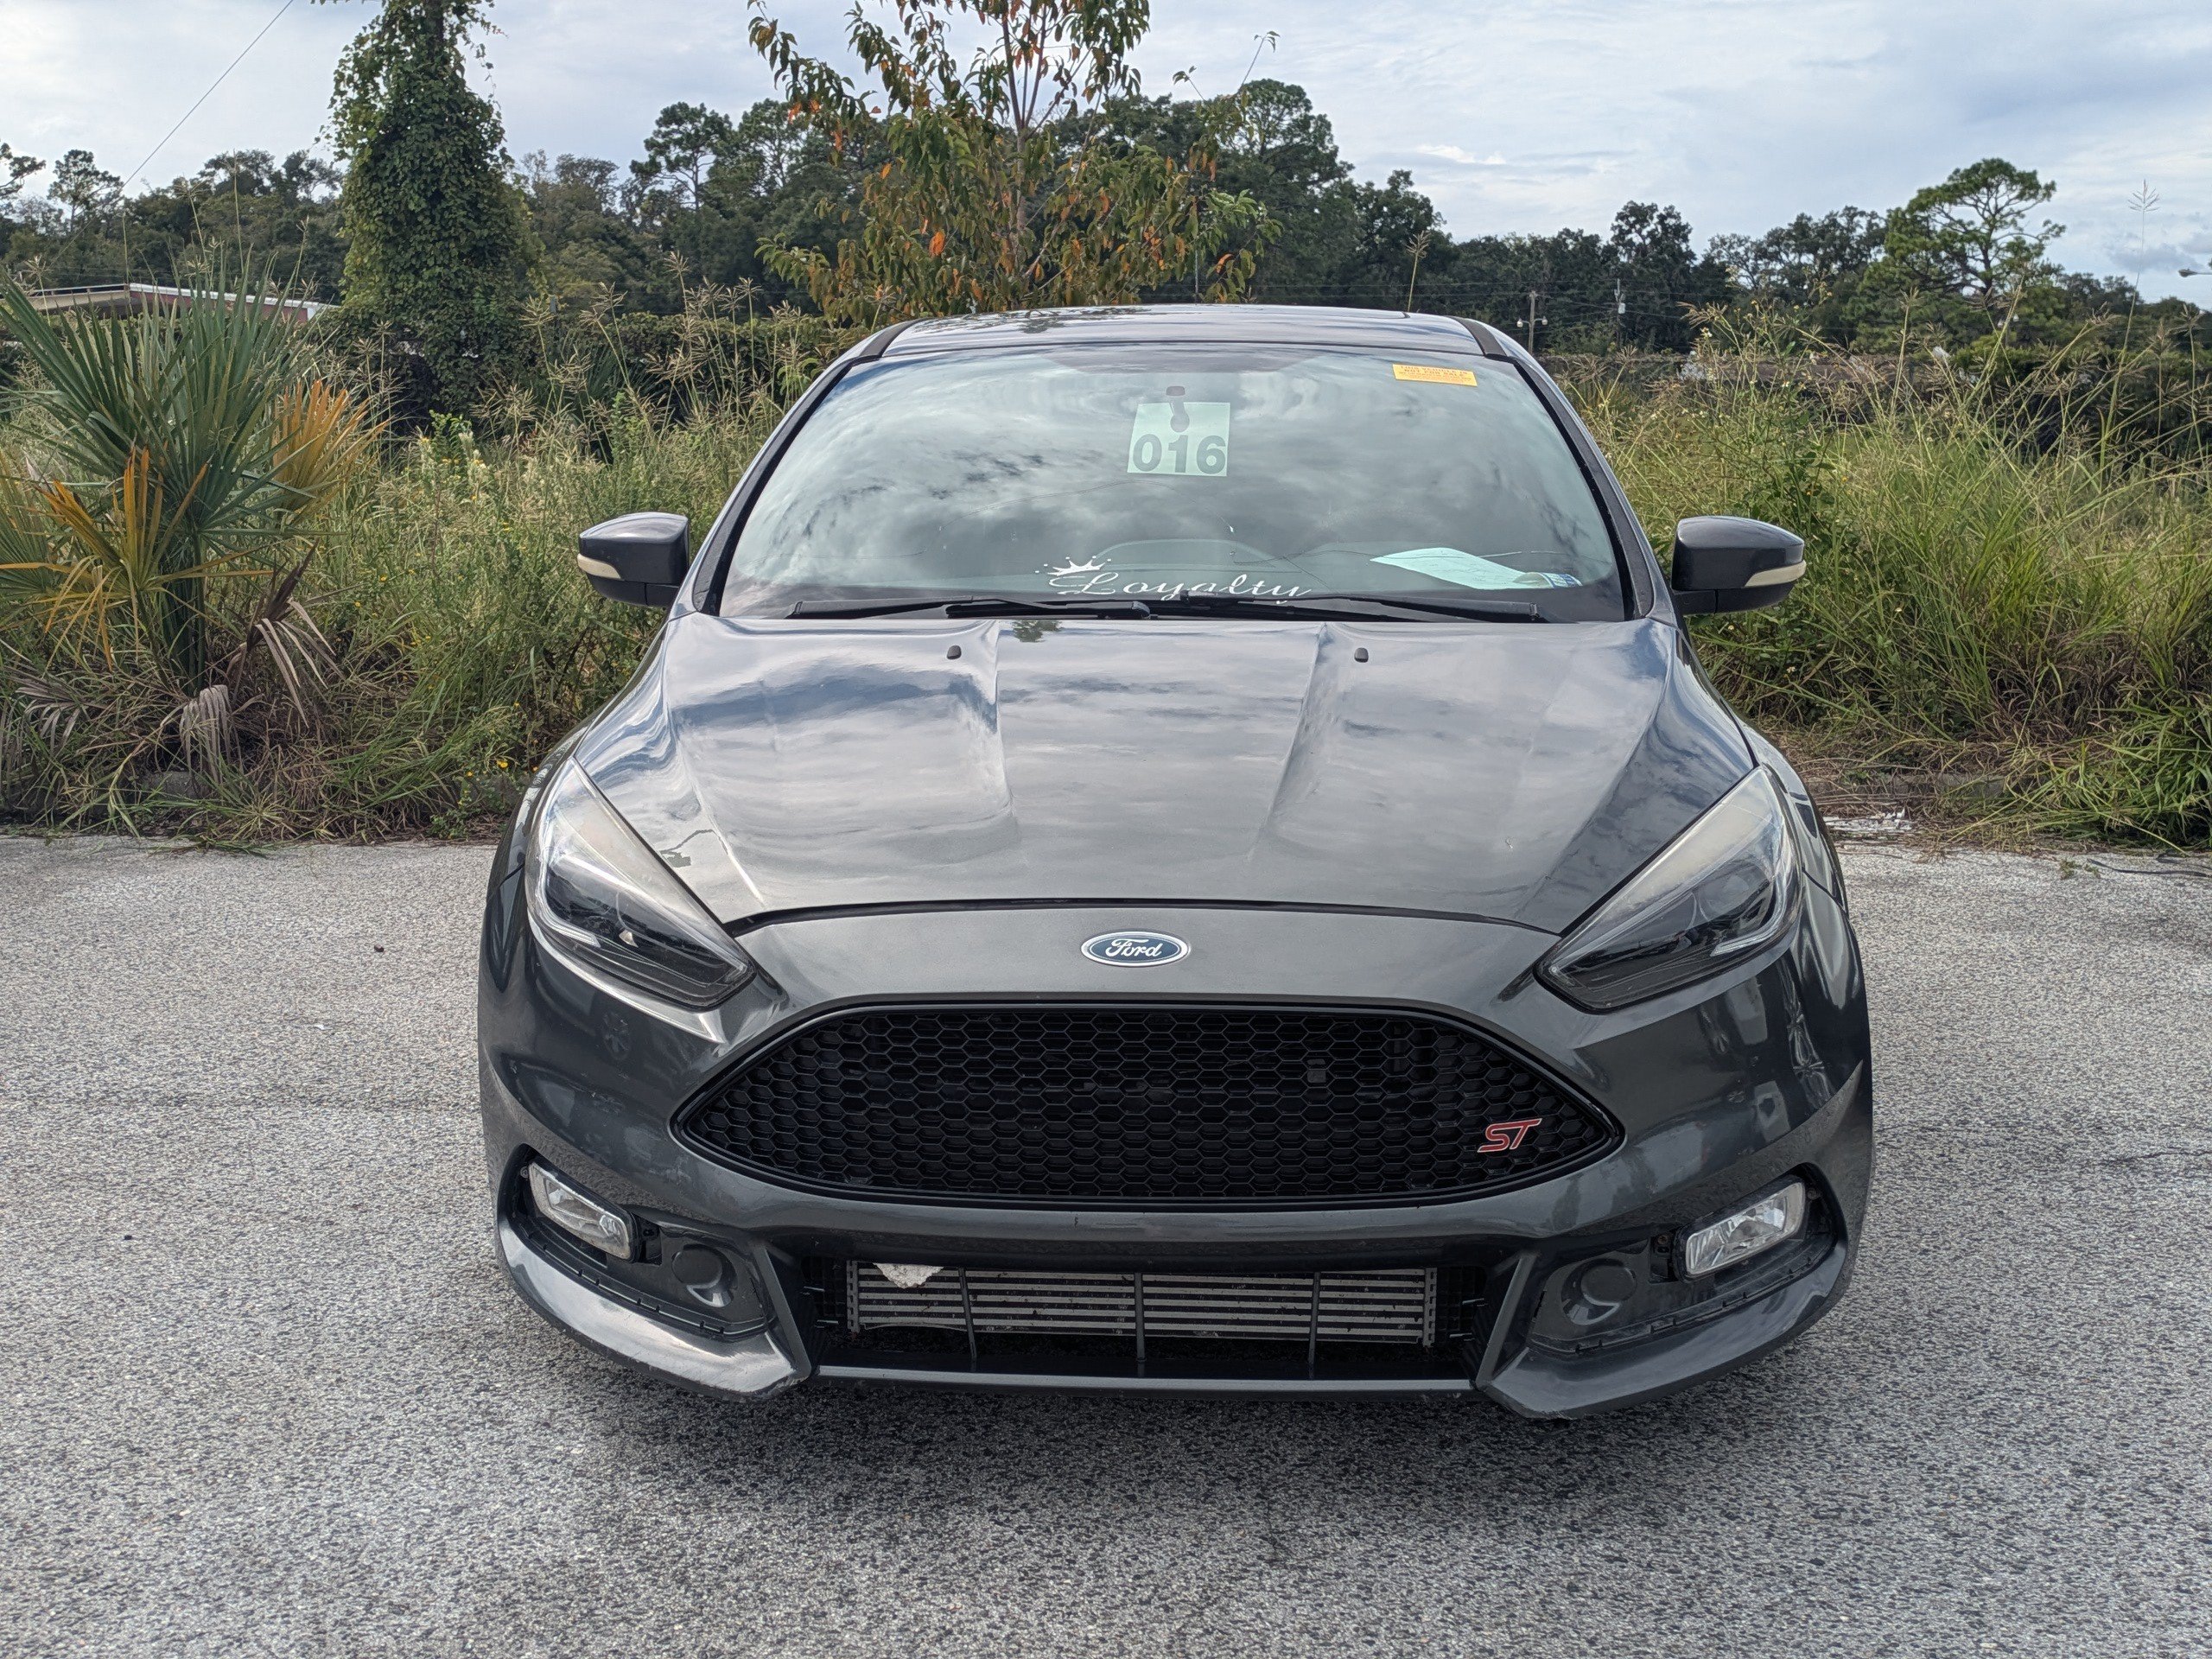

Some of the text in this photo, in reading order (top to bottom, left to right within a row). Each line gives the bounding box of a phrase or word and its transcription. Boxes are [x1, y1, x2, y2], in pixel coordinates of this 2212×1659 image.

[1132, 434, 1226, 474] 016
[1048, 571, 1311, 605] Loyalty
[1105, 938, 1164, 957] Ford
[1477, 1117, 1543, 1154] ST
